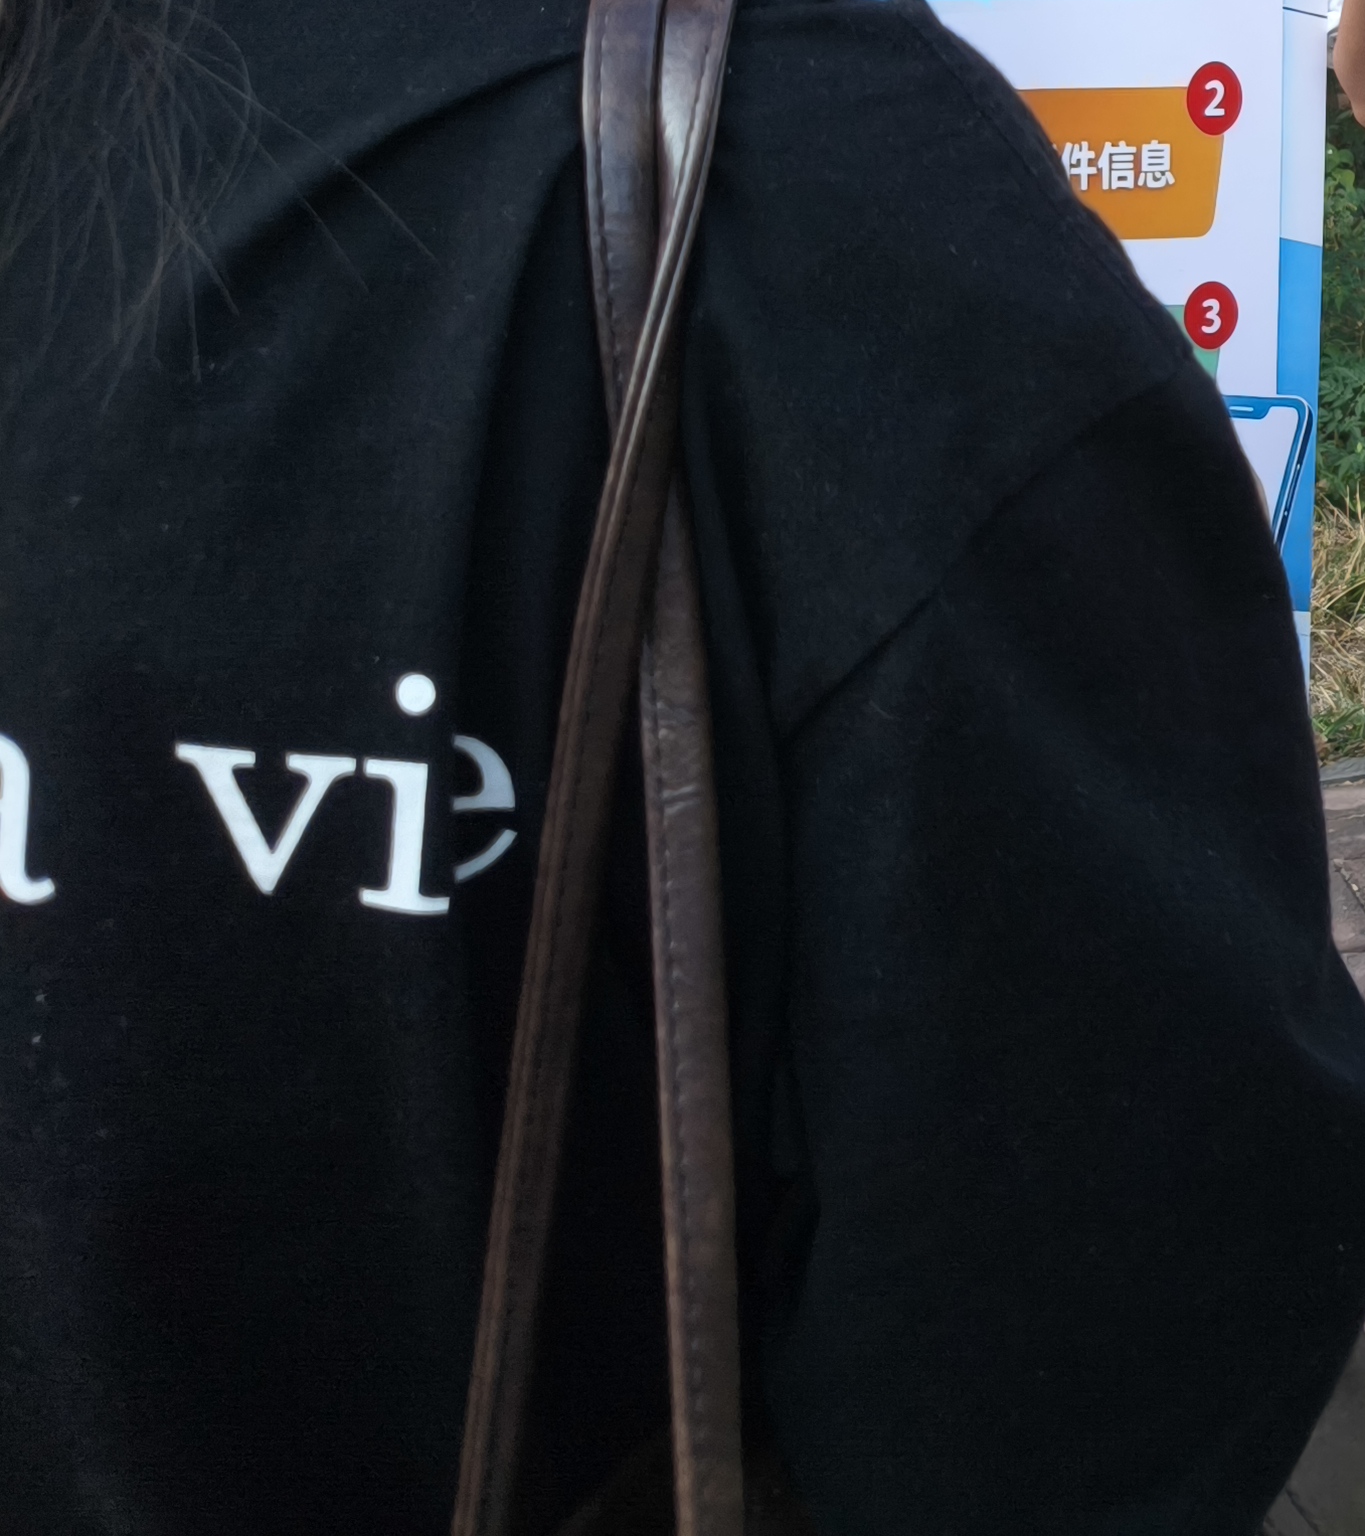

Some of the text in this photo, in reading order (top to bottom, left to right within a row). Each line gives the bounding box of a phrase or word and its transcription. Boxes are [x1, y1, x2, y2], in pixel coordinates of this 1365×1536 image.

[1203, 79, 1226, 117] 2
[1053, 139, 1175, 192] 件信息
[1201, 298, 1222, 334] 3
[174, 672, 518, 917] vie
